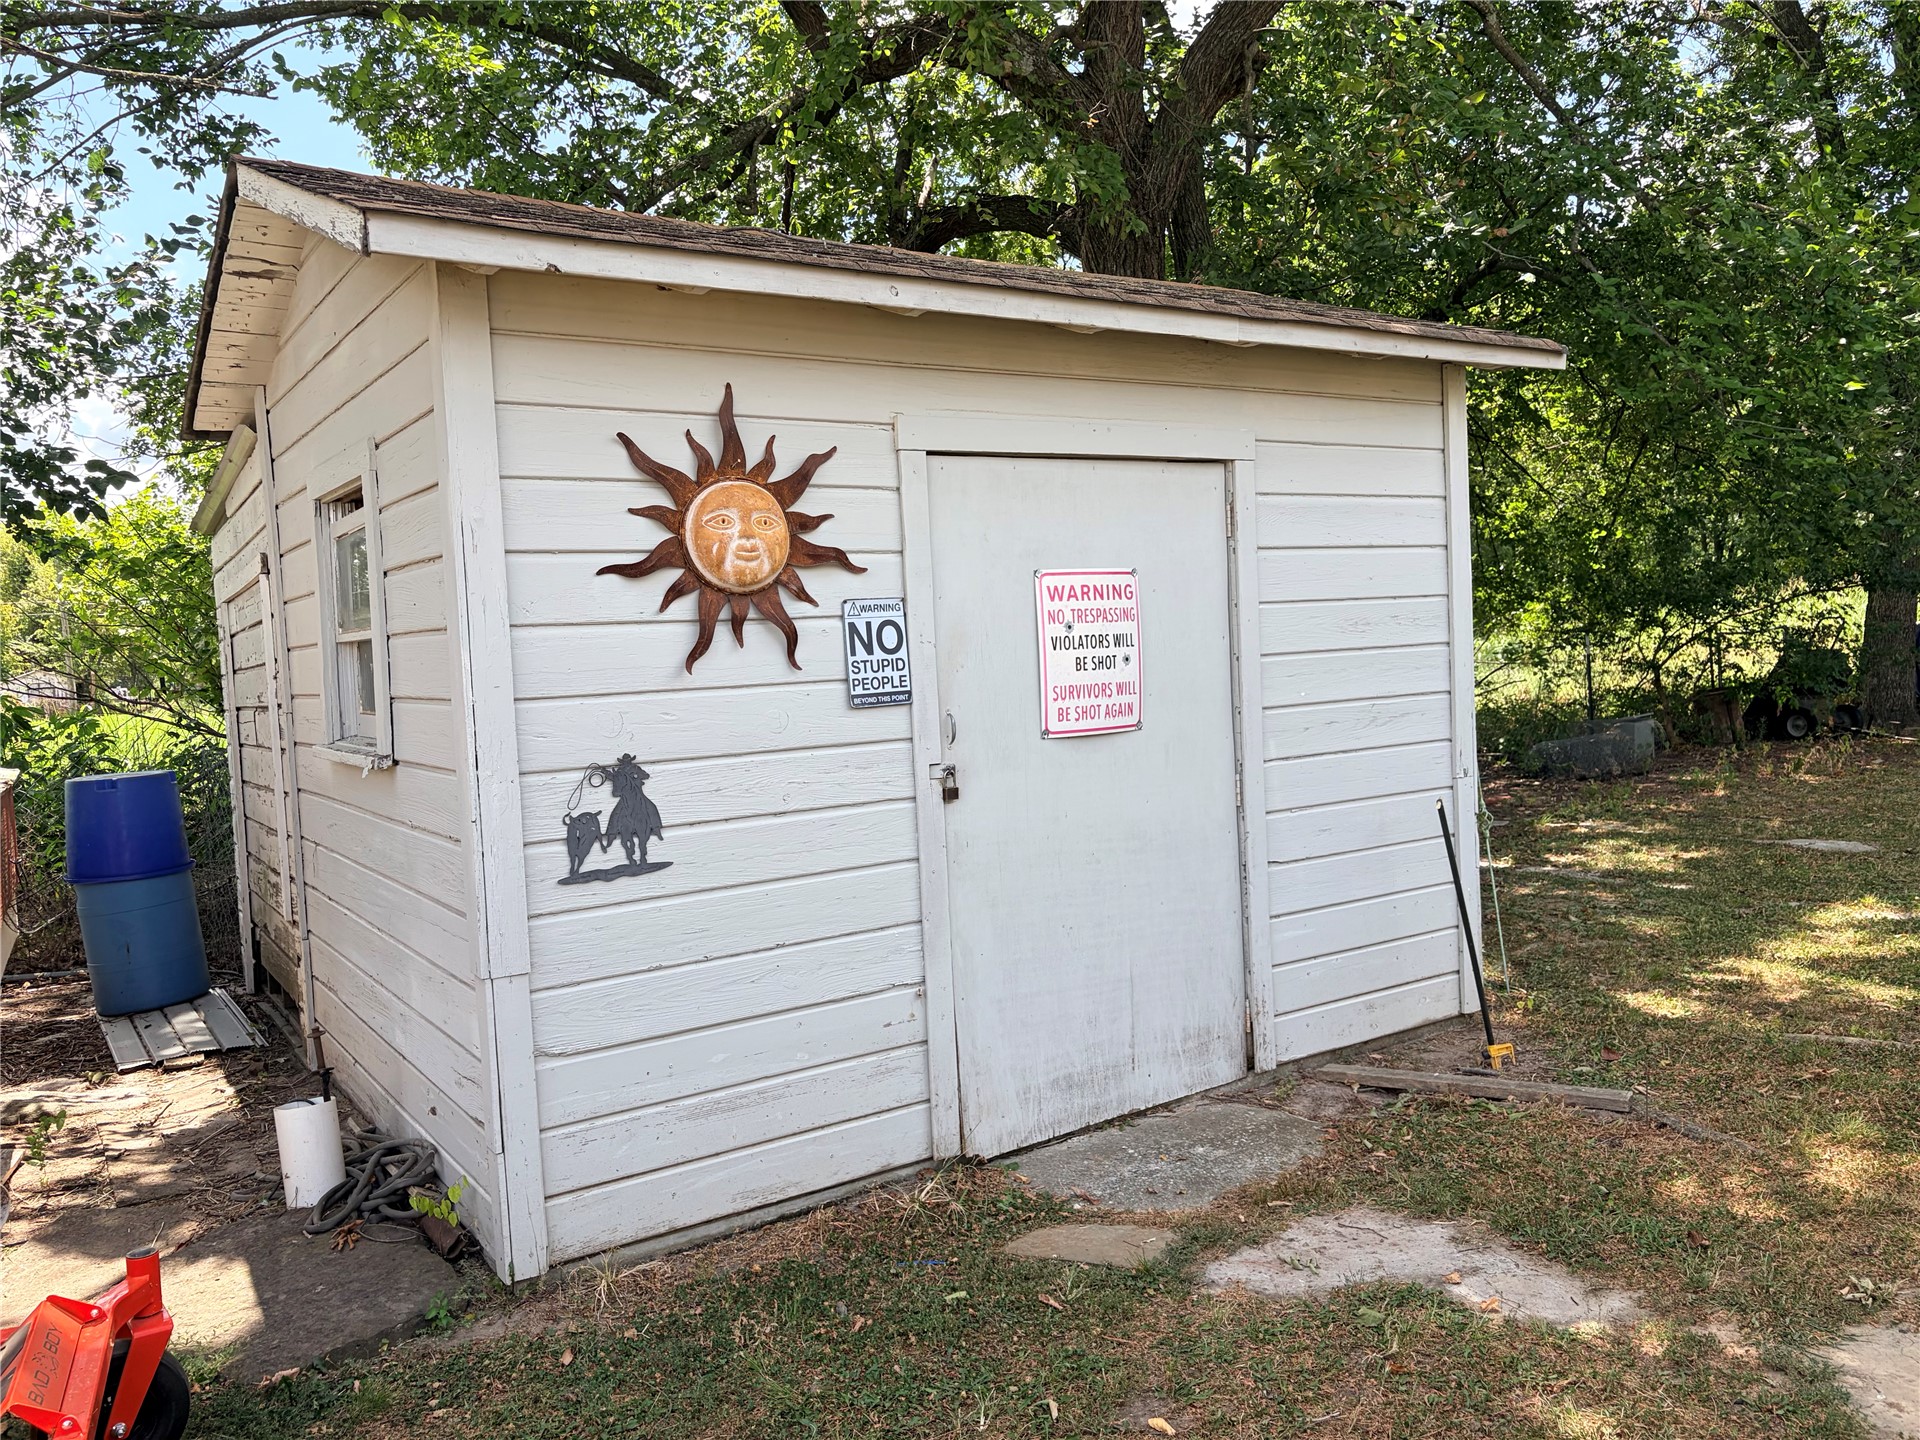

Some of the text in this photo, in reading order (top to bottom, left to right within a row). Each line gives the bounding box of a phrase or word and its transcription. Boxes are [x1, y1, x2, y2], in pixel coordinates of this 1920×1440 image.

[1046, 583, 1134, 602] WARNING
[859, 602, 901, 613] WARNING
[1047, 606, 1136, 625] NO TRESPASSING
[847, 618, 904, 657] NO
[1050, 632, 1135, 651] VIOLATORS WILL
[850, 657, 906, 675] STUPID
[1075, 654, 1117, 672] BE SHOT
[851, 674, 908, 692] PEOPLE
[1052, 680, 1137, 702] SURVIVORS WILL
[853, 694, 909, 705] BEYOND THIS POINT
[1057, 701, 1134, 723] BE SHOT AGAIN
[27, 1322, 63, 1406] BAD BOY
